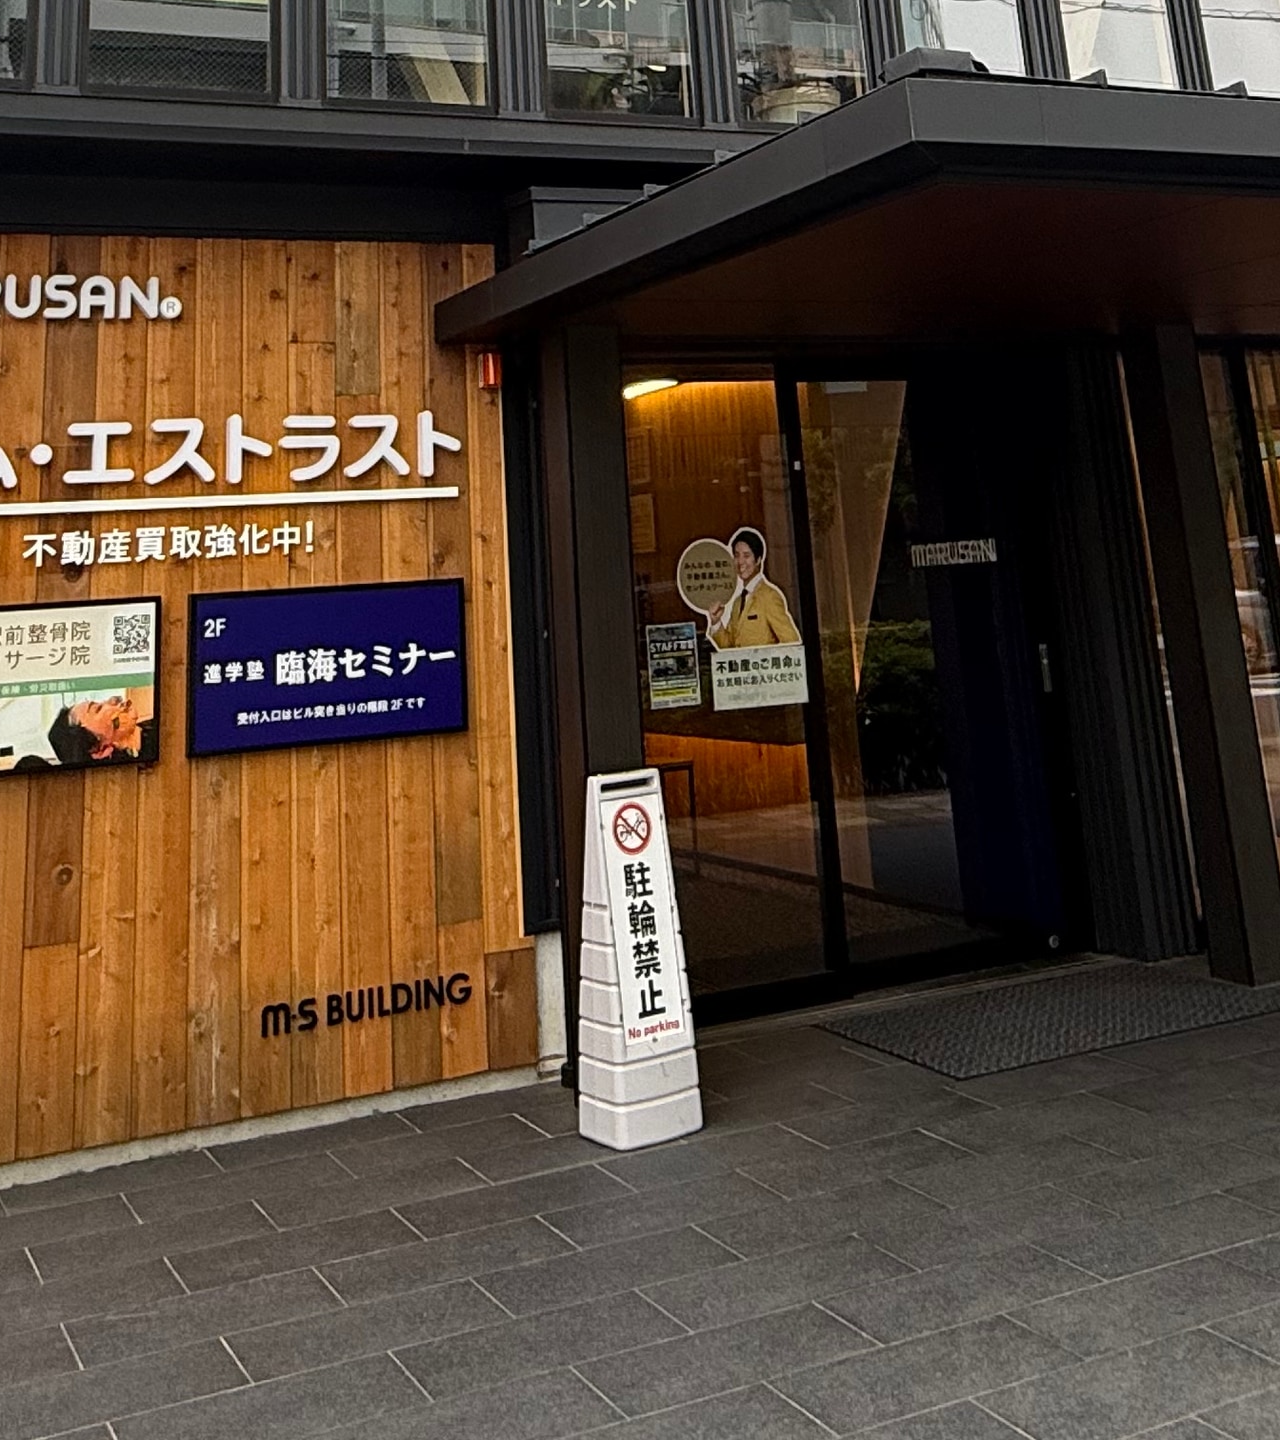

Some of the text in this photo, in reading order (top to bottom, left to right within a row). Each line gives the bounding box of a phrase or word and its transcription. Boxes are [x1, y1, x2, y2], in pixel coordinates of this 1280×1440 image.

[23, 521, 314, 568] 不動産買取強化中!
[911, 538, 997, 568] MARUSAN
[204, 618, 226, 638] 2F
[203, 643, 456, 685] 進学塾 臨海セミナー
[623, 861, 666, 1019] 駐輪禁止
[327, 973, 472, 1026] BUILDING
[628, 1018, 680, 1040] No parking
